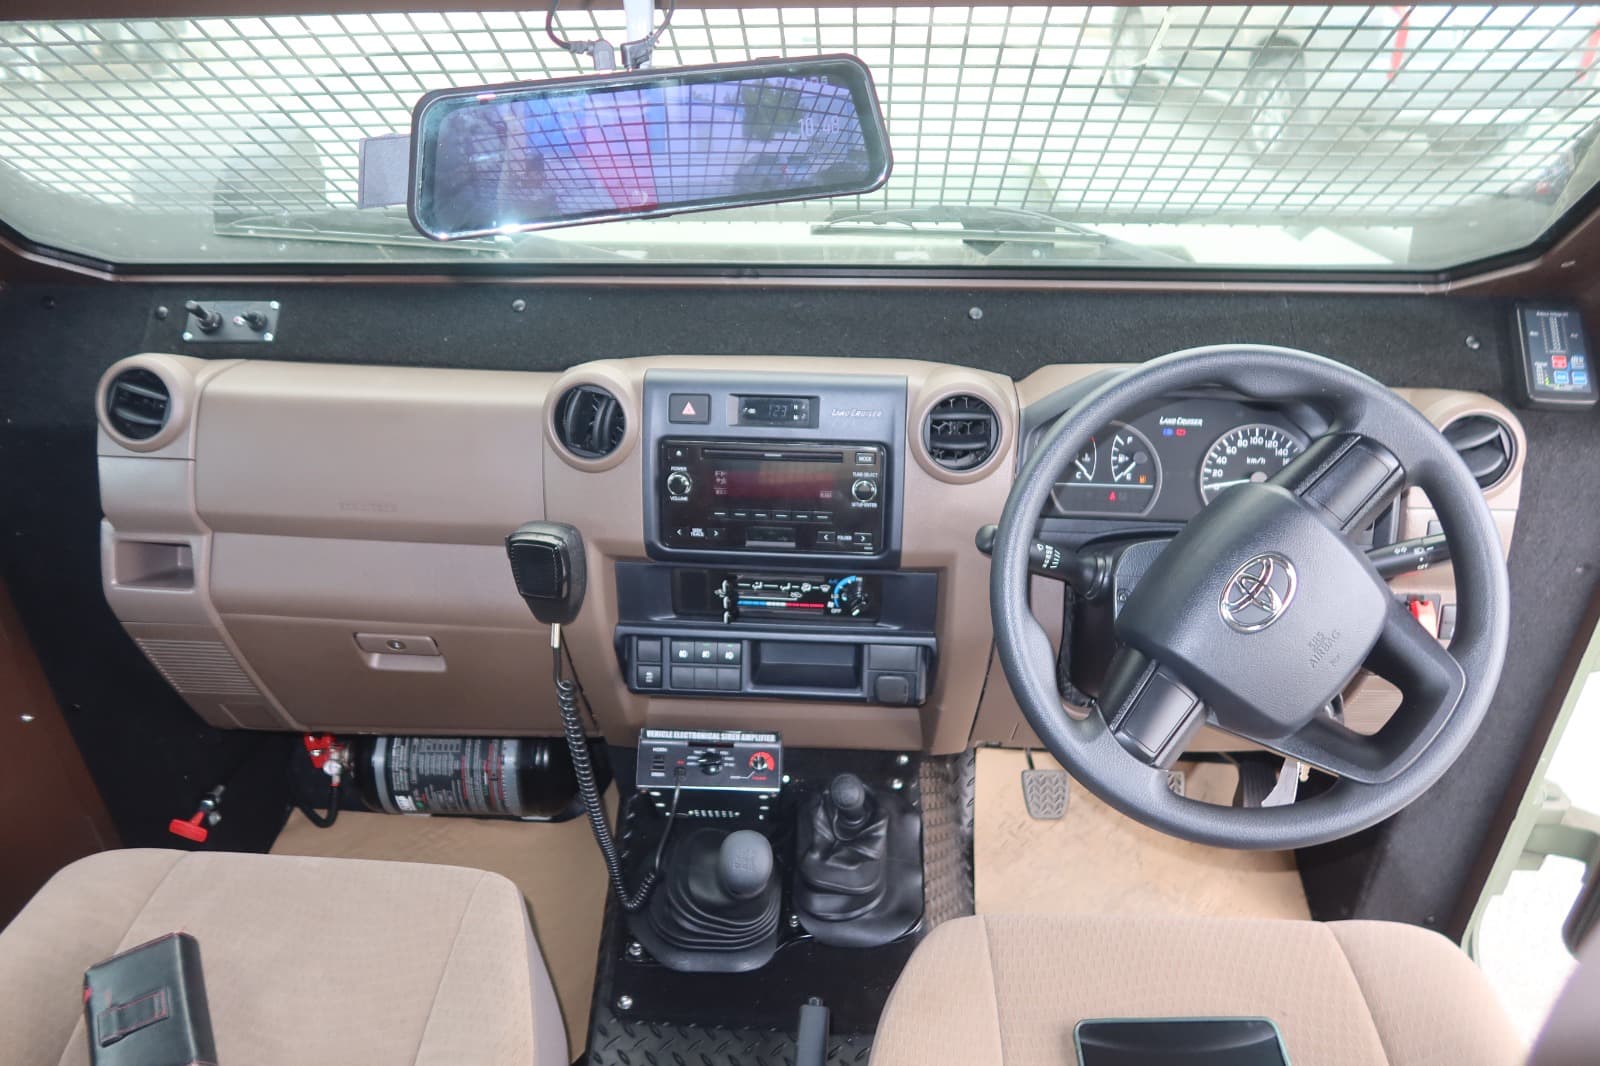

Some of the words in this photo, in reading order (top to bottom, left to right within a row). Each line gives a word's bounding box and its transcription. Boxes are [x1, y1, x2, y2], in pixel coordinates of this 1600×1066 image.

[1159, 416, 1176, 426] LAND
[1176, 416, 1203, 427] CRUISER
[1237, 439, 1248, 448] 80
[1250, 436, 1264, 445] 100
[1265, 440, 1279, 449] 120
[1275, 448, 1289, 457] 140
[1216, 456, 1228, 465] 40
[1246, 457, 1266, 465] km/h
[1212, 469, 1223, 478] 20
